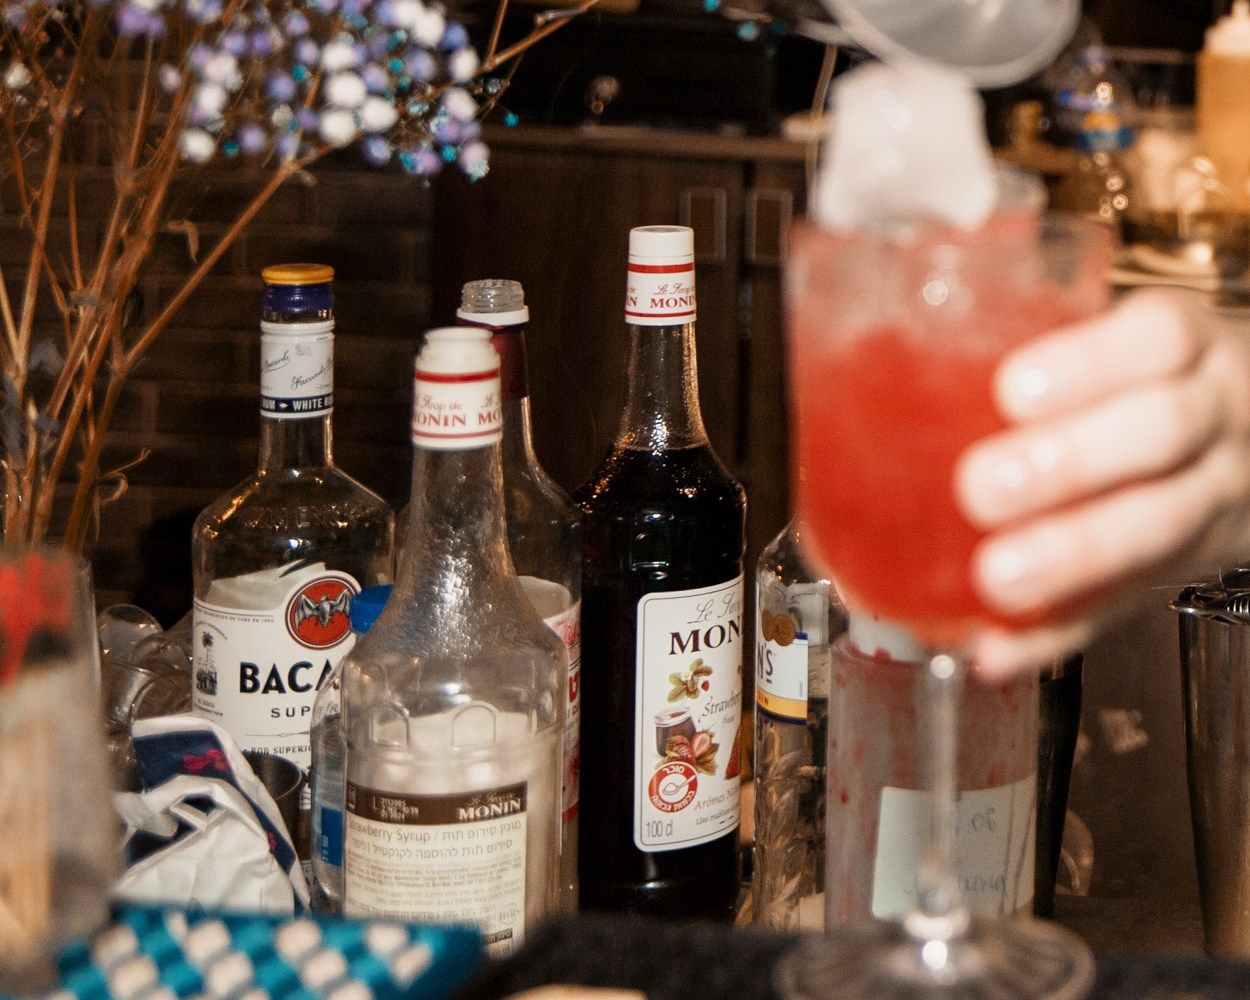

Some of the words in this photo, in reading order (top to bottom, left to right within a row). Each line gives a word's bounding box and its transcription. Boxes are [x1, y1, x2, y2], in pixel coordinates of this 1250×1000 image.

[292, 398, 323, 411] WHITE
[687, 599, 715, 624] Le
[662, 764, 686, 775] סוכר
[458, 797, 523, 820] MONIN
[441, 830, 464, 841] תות
[467, 825, 498, 839] סירופ
[645, 821, 664, 838] 100
[665, 819, 674, 837] cl
[396, 829, 431, 844] Syrup
[461, 845, 484, 857] תות
[486, 838, 513, 854] סירופ
